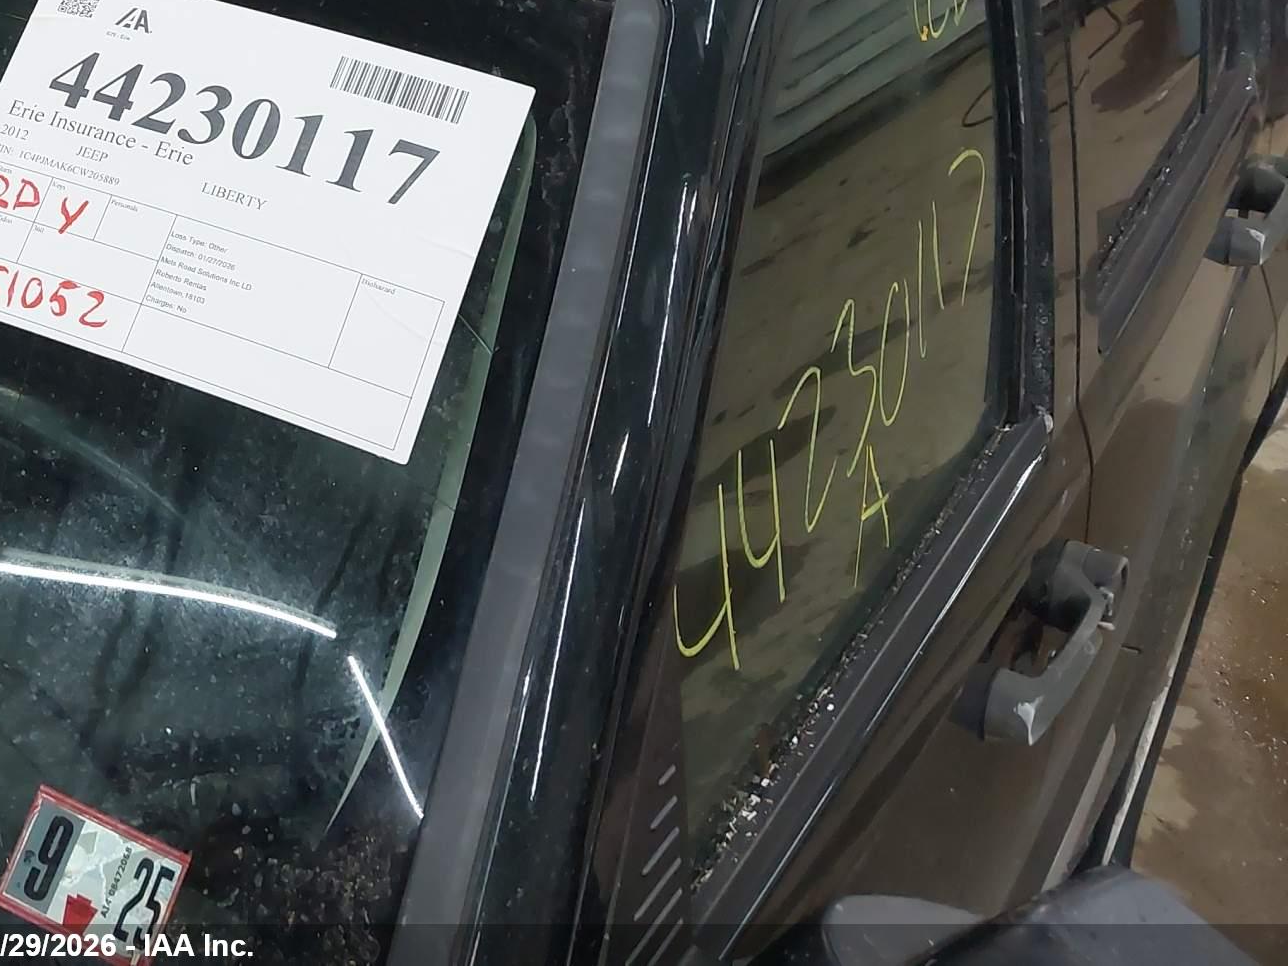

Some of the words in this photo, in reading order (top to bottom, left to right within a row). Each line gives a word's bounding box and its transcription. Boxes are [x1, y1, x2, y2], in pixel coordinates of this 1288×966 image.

[0, 123, 29, 140] 2012
[8, 99, 45, 123] Erie
[48, 109, 136, 149] Insurance
[154, 140, 194, 166] Erie
[49, 52, 440, 205] 44230117
[75, 145, 109, 162] JEEP
[201, 182, 268, 211] LIBERTY
[58, 197, 89, 234] Y
[171, 231, 187, 241] Loss
[189, 236, 207, 247] Type:
[208, 242, 229, 253] Other
[156, 269, 182, 282] Roberto
[178, 261, 197, 273] Road
[197, 268, 228, 283] Solutions
[229, 278, 240, 287] Inc
[145, 294, 175, 309] Charges:
[177, 305, 187, 313] No
[674, 148, 986, 672] 44230117
[853, 444, 890, 589] A
[24, 815, 74, 901] 9
[112, 857, 175, 951] 25
